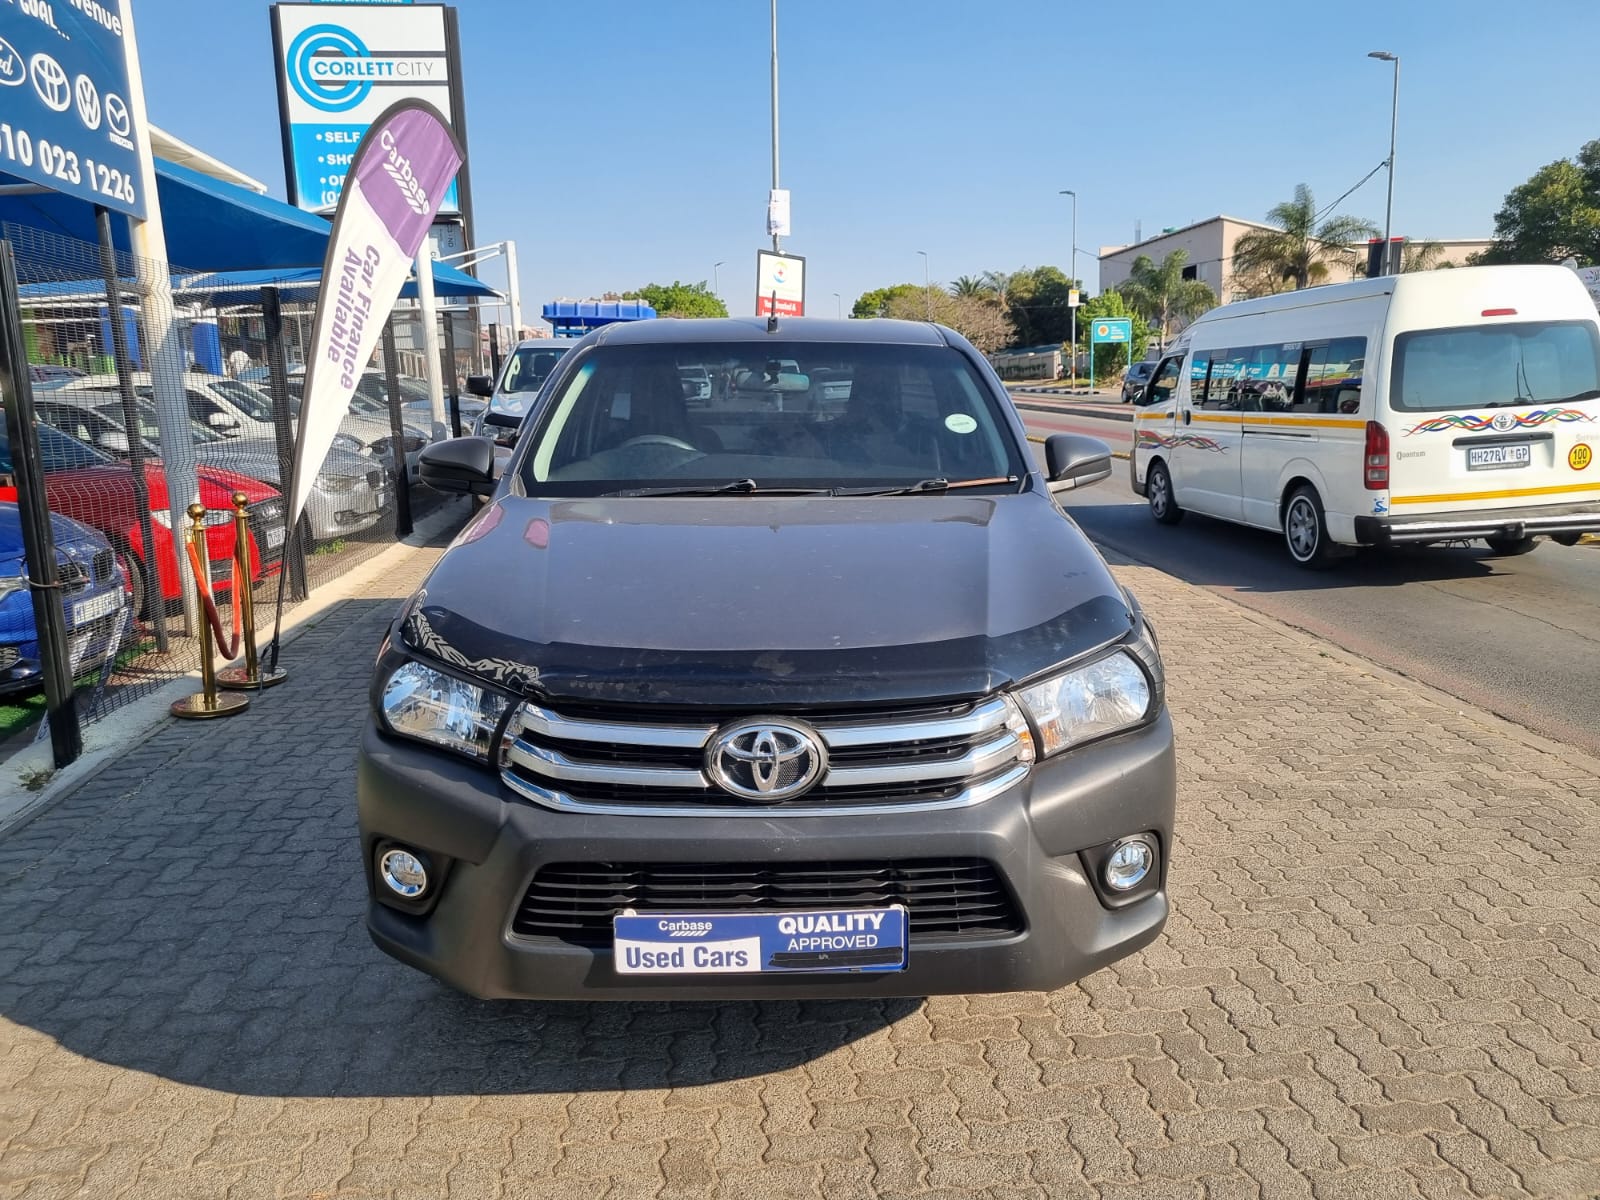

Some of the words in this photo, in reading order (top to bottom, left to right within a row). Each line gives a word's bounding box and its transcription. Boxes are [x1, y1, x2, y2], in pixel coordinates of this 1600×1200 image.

[324, 131, 361, 143] SELF
[0, 123, 33, 167] 10
[39, 139, 81, 185] 023
[86, 158, 135, 205] 1226
[380, 129, 431, 215] Carbase
[361, 245, 381, 289] Car
[327, 246, 363, 363] Available
[340, 291, 372, 390] Finance
[1515, 447, 1528, 460] GP
[1573, 448, 1588, 461] 100
[658, 920, 713, 931] Carbase
[778, 912, 886, 935] QUALITY
[787, 934, 878, 951] APPROVED
[625, 946, 685, 968] Used
[693, 945, 749, 967] Cars
